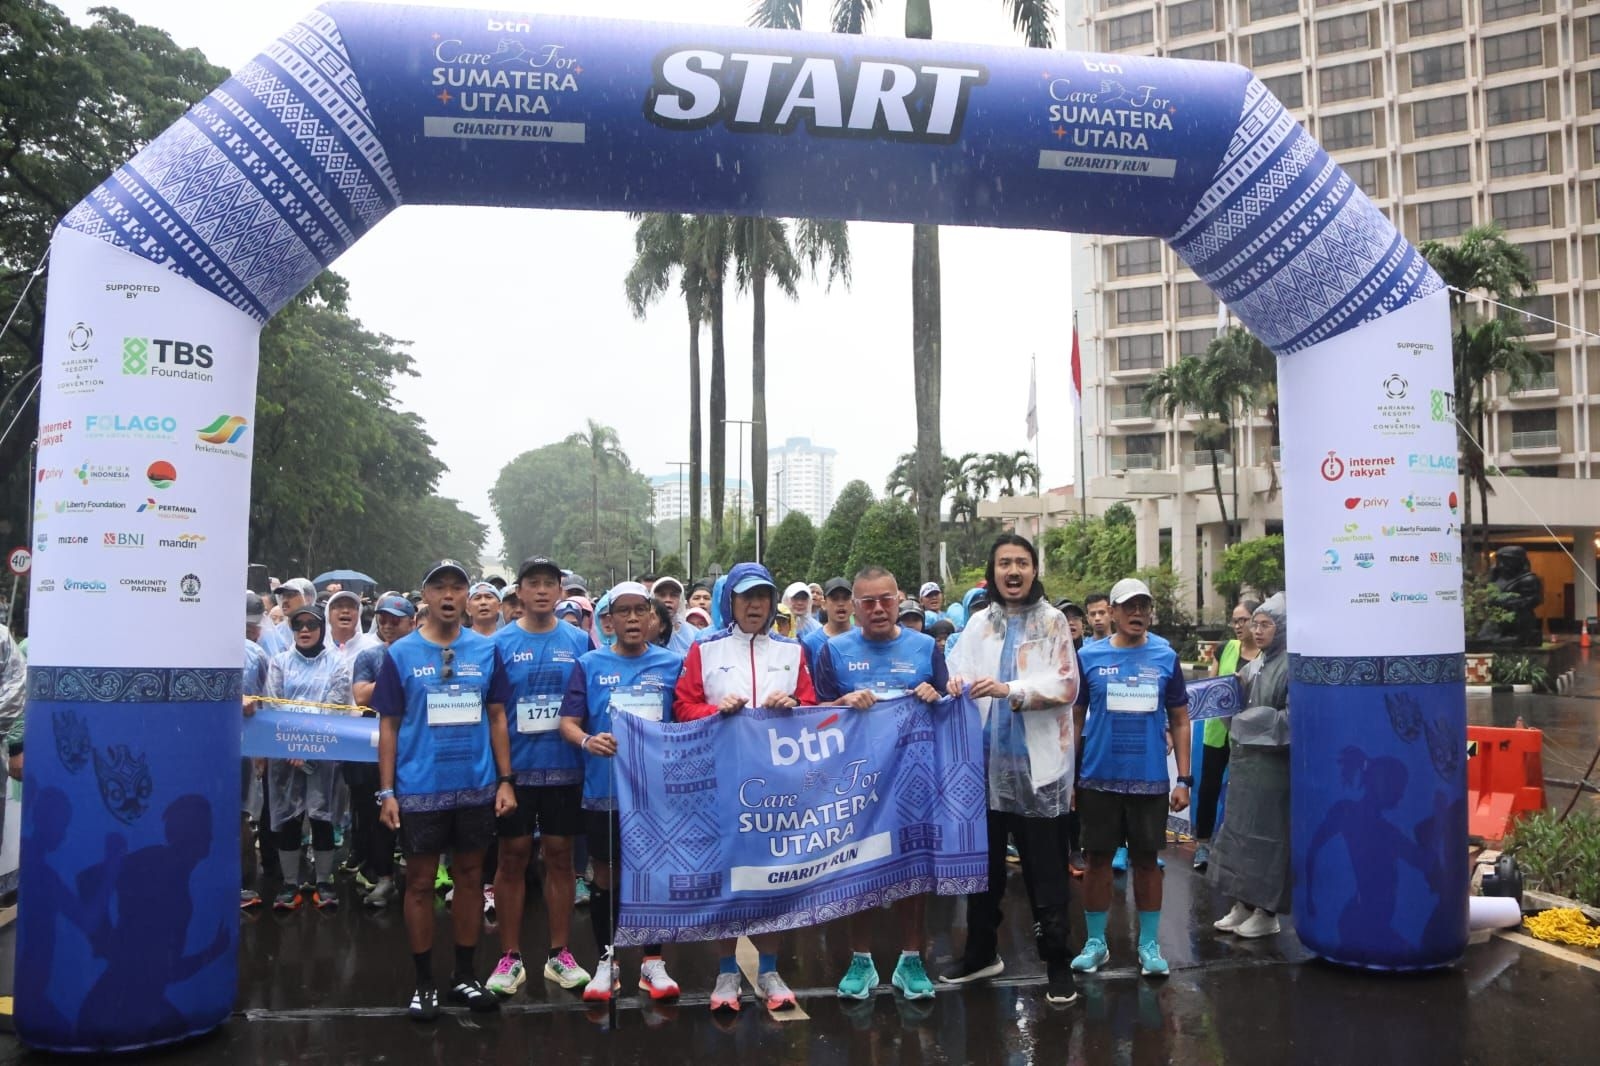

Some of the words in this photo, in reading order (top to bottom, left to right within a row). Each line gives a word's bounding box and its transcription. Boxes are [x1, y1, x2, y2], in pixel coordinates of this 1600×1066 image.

[487, 19, 530, 33] btn
[435, 39, 491, 65] Care
[529, 44, 576, 70] For
[1082, 59, 1123, 74] btn
[432, 67, 578, 92] SUMATERA
[652, 49, 981, 135] START
[1049, 78, 1098, 104] Care
[1130, 85, 1170, 109] For
[460, 92, 550, 114] UTARA
[1048, 105, 1173, 131] SUMATERA
[453, 122, 519, 137] CHARITY
[521, 124, 553, 138] RUN
[1073, 128, 1149, 151] UTARA
[1064, 156, 1122, 170] CHARITY
[1122, 160, 1150, 172] RUN
[105, 283, 160, 293] SUPPORTED
[152, 339, 214, 369] TBS
[1396, 342, 1434, 351] SUPPORTED
[151, 366, 213, 383] Foundation
[85, 415, 177, 432] FOLAGO
[1349, 457, 1396, 467] internet
[1349, 467, 1386, 478] rakyat
[66, 500, 86, 509] Liberty
[87, 501, 126, 509] Foundation
[158, 505, 197, 513] PERTAMINA
[1363, 497, 1389, 509] privy
[58, 536, 89, 544] mizone
[118, 533, 145, 545] BNI
[159, 539, 197, 549] mandiri
[512, 648, 534, 663] btn
[413, 662, 436, 677] btn
[848, 660, 870, 671] btn
[599, 674, 620, 685] btn
[527, 707, 558, 721] 1717
[275, 732, 338, 744] SUMATERA
[768, 713, 845, 767] btn
[287, 744, 326, 753] UTARA
[739, 778, 799, 808] Care
[835, 759, 881, 796] For
[739, 791, 879, 833] SUMATERA
[770, 822, 855, 857] UTARA
[767, 861, 830, 884] CHARITY
[830, 848, 858, 867] RUN
